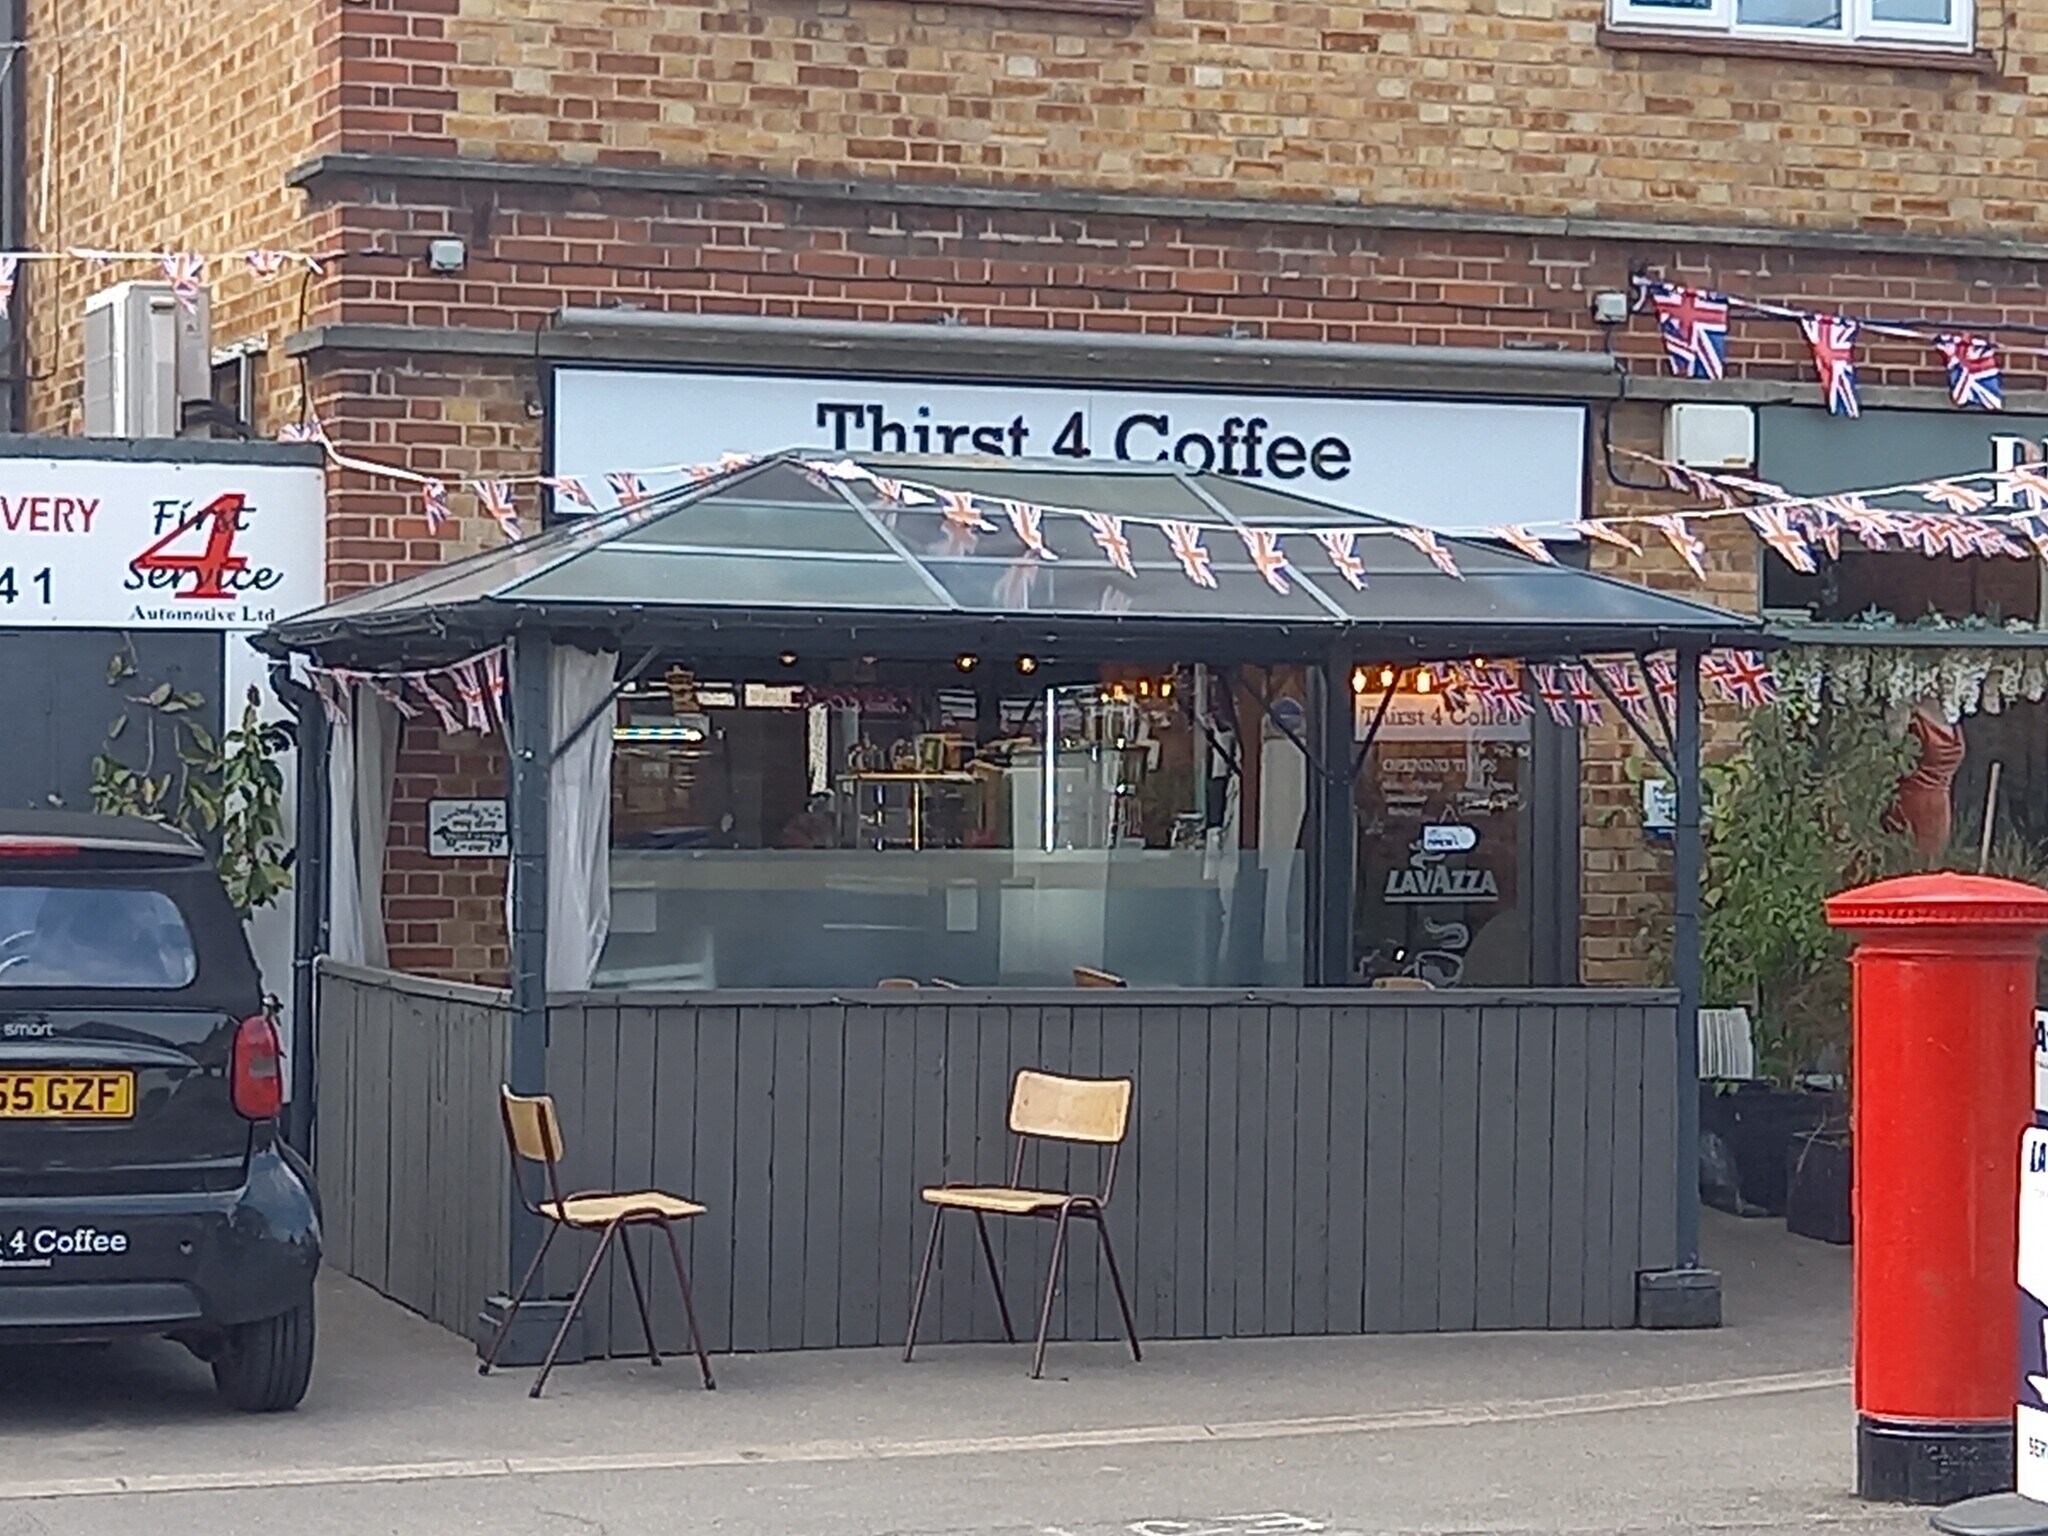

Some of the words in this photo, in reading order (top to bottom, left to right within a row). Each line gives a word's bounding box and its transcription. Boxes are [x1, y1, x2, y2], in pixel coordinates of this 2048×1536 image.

[817, 402, 1029, 458] Thirst
[1052, 411, 1090, 459] 4
[1115, 413, 1352, 480] Coffee
[0, 496, 100, 533] VERY
[132, 494, 248, 600] 4
[123, 560, 284, 591] Service
[128, 604, 236, 622] Automotive
[242, 605, 276, 623] Ltd
[1384, 864, 1499, 895] LAVAZZA
[4, 1023, 54, 1036] smart
[47, 1078, 120, 1110] GZF
[9, 1229, 27, 1255] 4
[34, 1228, 127, 1253] Coffee
